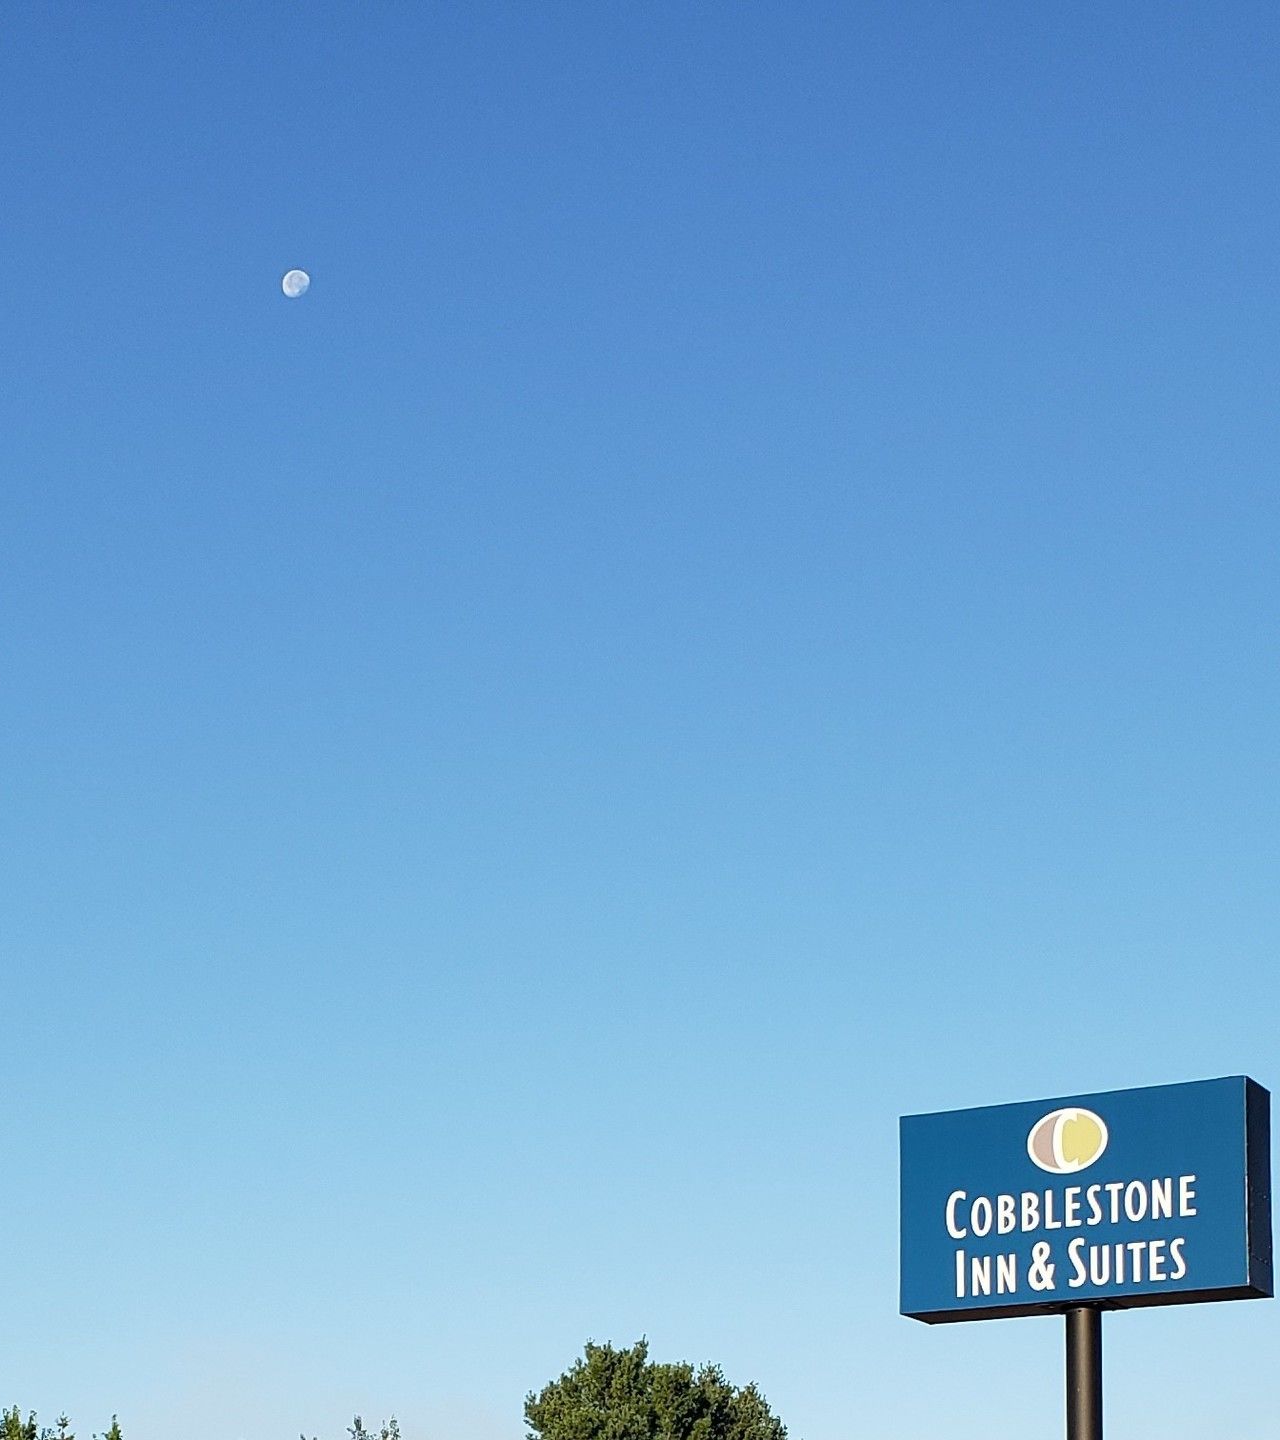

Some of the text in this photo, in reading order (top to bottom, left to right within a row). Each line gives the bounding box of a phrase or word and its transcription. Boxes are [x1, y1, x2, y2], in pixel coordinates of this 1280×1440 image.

[945, 1174, 1197, 1240] COBBLESTONE
[955, 1237, 1187, 1298] INN & SUITES
